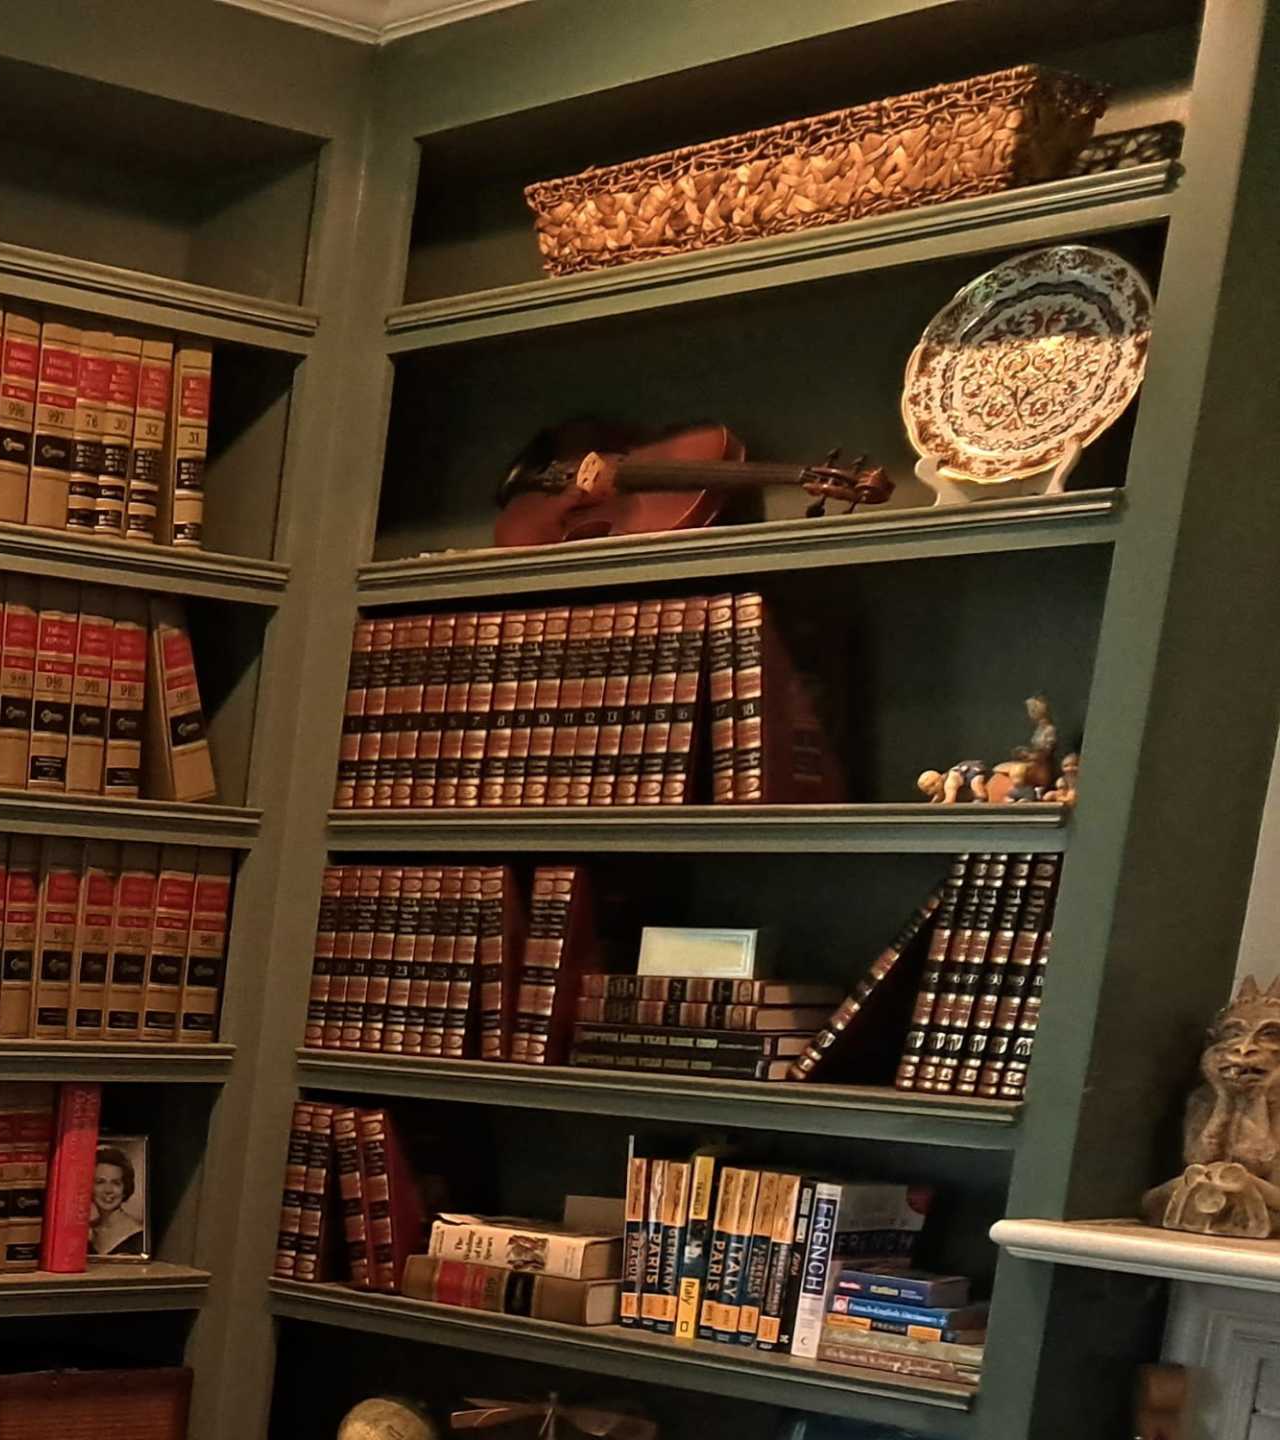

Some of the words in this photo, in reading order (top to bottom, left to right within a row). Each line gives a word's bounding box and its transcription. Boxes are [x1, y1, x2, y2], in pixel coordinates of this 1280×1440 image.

[538, 713, 549, 724] 10
[585, 712, 595, 723] 12
[607, 711, 617, 722] 13
[654, 708, 665, 720] 15
[395, 966, 409, 977] 23
[646, 1234, 662, 1284] PARIS
[805, 1203, 834, 1291] FRENCH
[663, 1227, 678, 1295] GERMANY
[706, 1240, 726, 1292] PARIS
[723, 1241, 745, 1299] ITALY
[681, 1280, 696, 1305] Italy
